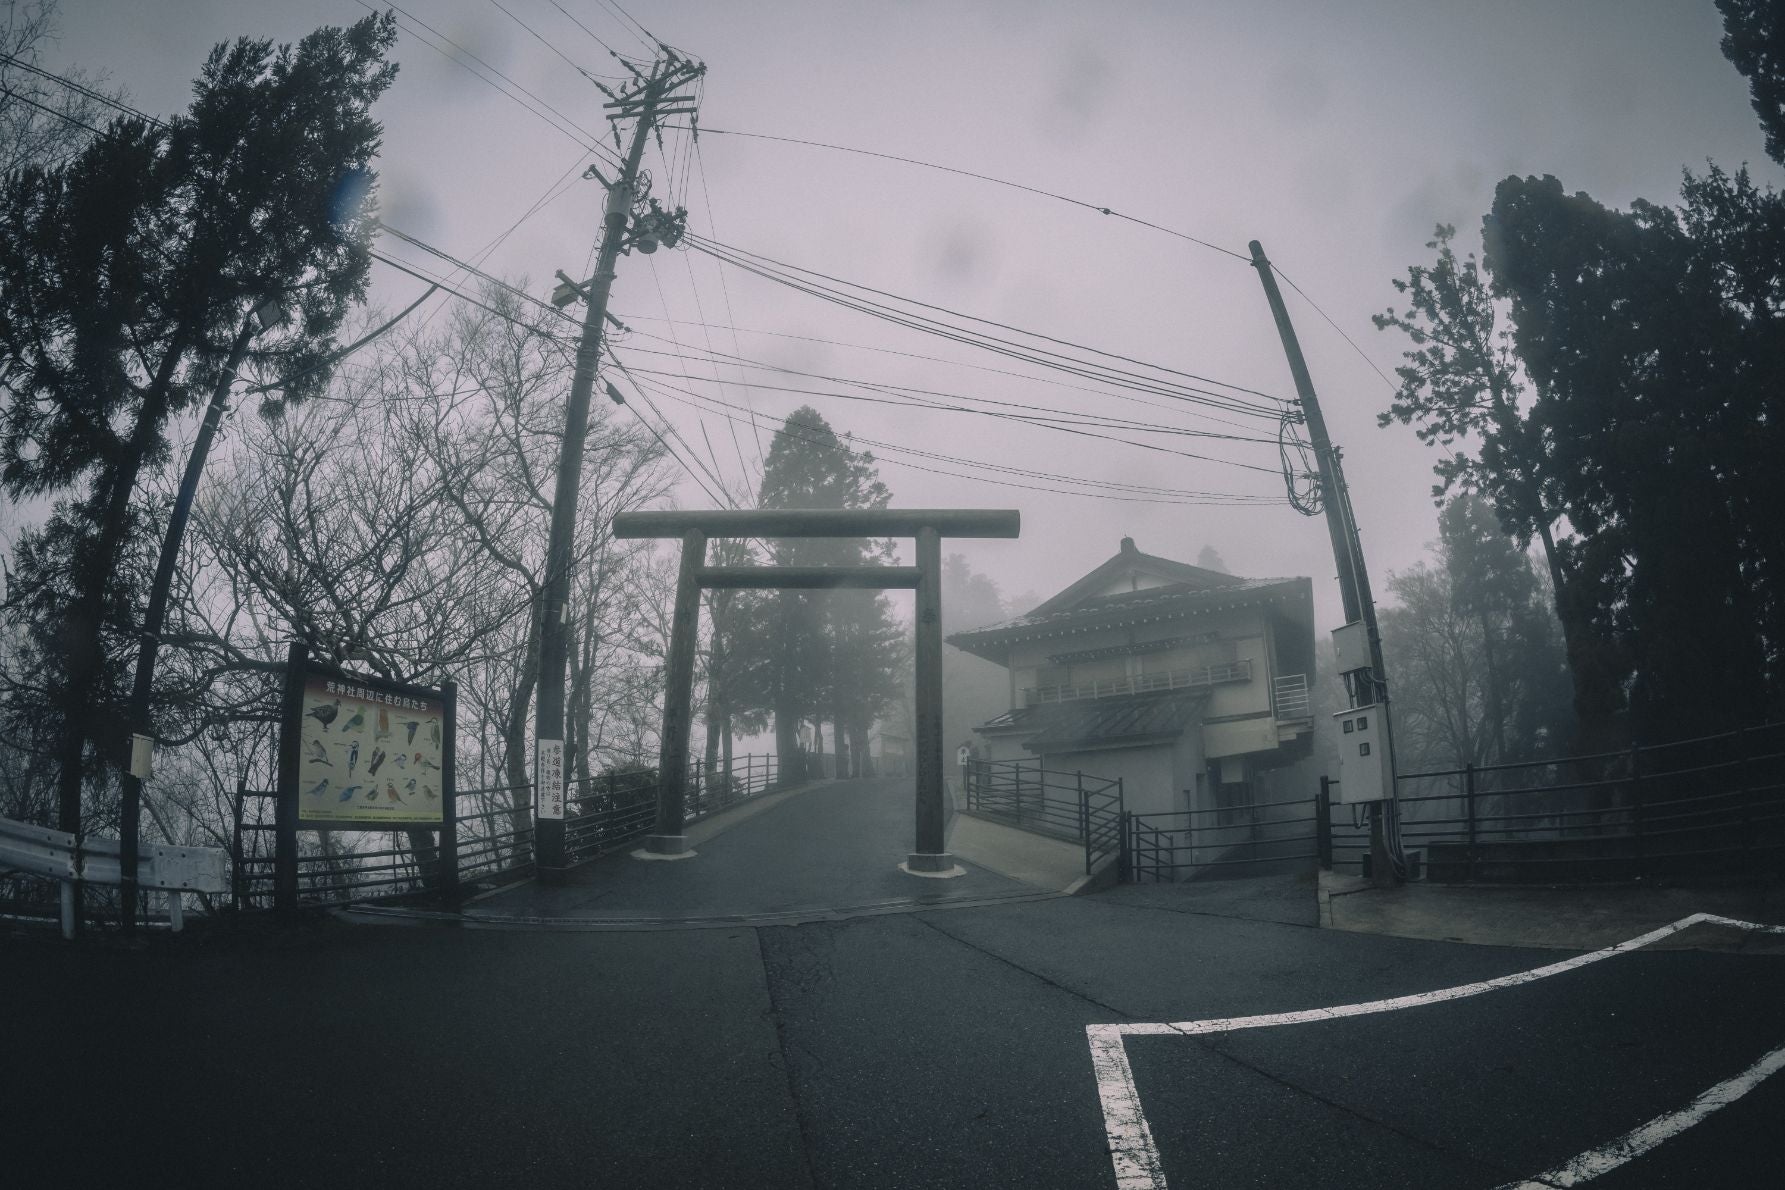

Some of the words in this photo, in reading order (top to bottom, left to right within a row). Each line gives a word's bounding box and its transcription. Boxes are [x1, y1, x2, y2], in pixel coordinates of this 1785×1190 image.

[552, 744, 562, 815] 参道凍結注意
